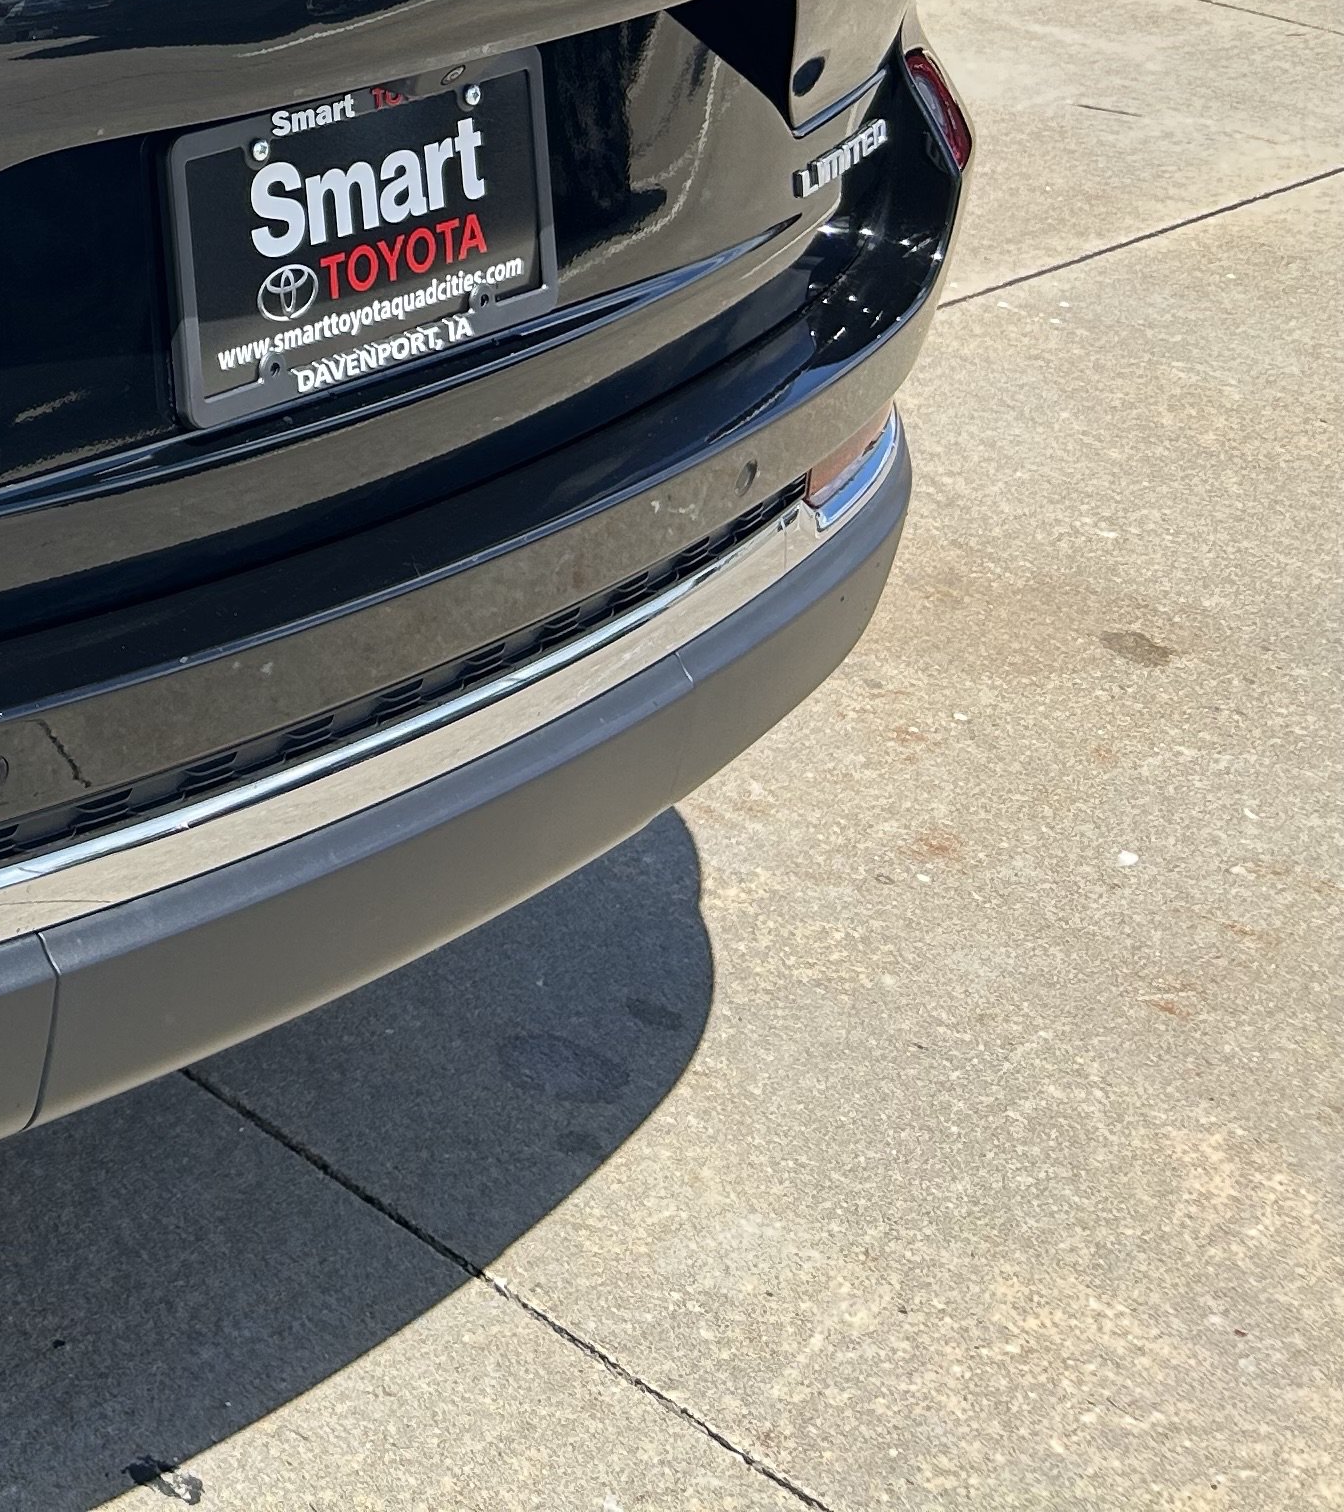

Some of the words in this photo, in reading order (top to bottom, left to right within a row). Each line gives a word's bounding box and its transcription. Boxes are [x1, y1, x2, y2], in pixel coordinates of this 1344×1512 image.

[271, 94, 356, 137] Smart
[250, 118, 486, 257] Smart
[794, 118, 888, 199] LIMITED
[319, 214, 488, 300] TOYOTA
[217, 257, 524, 371] www.smarttoyotaquadcities.com
[292, 327, 444, 394] DAVENPORT,
[444, 315, 474, 343] IA
